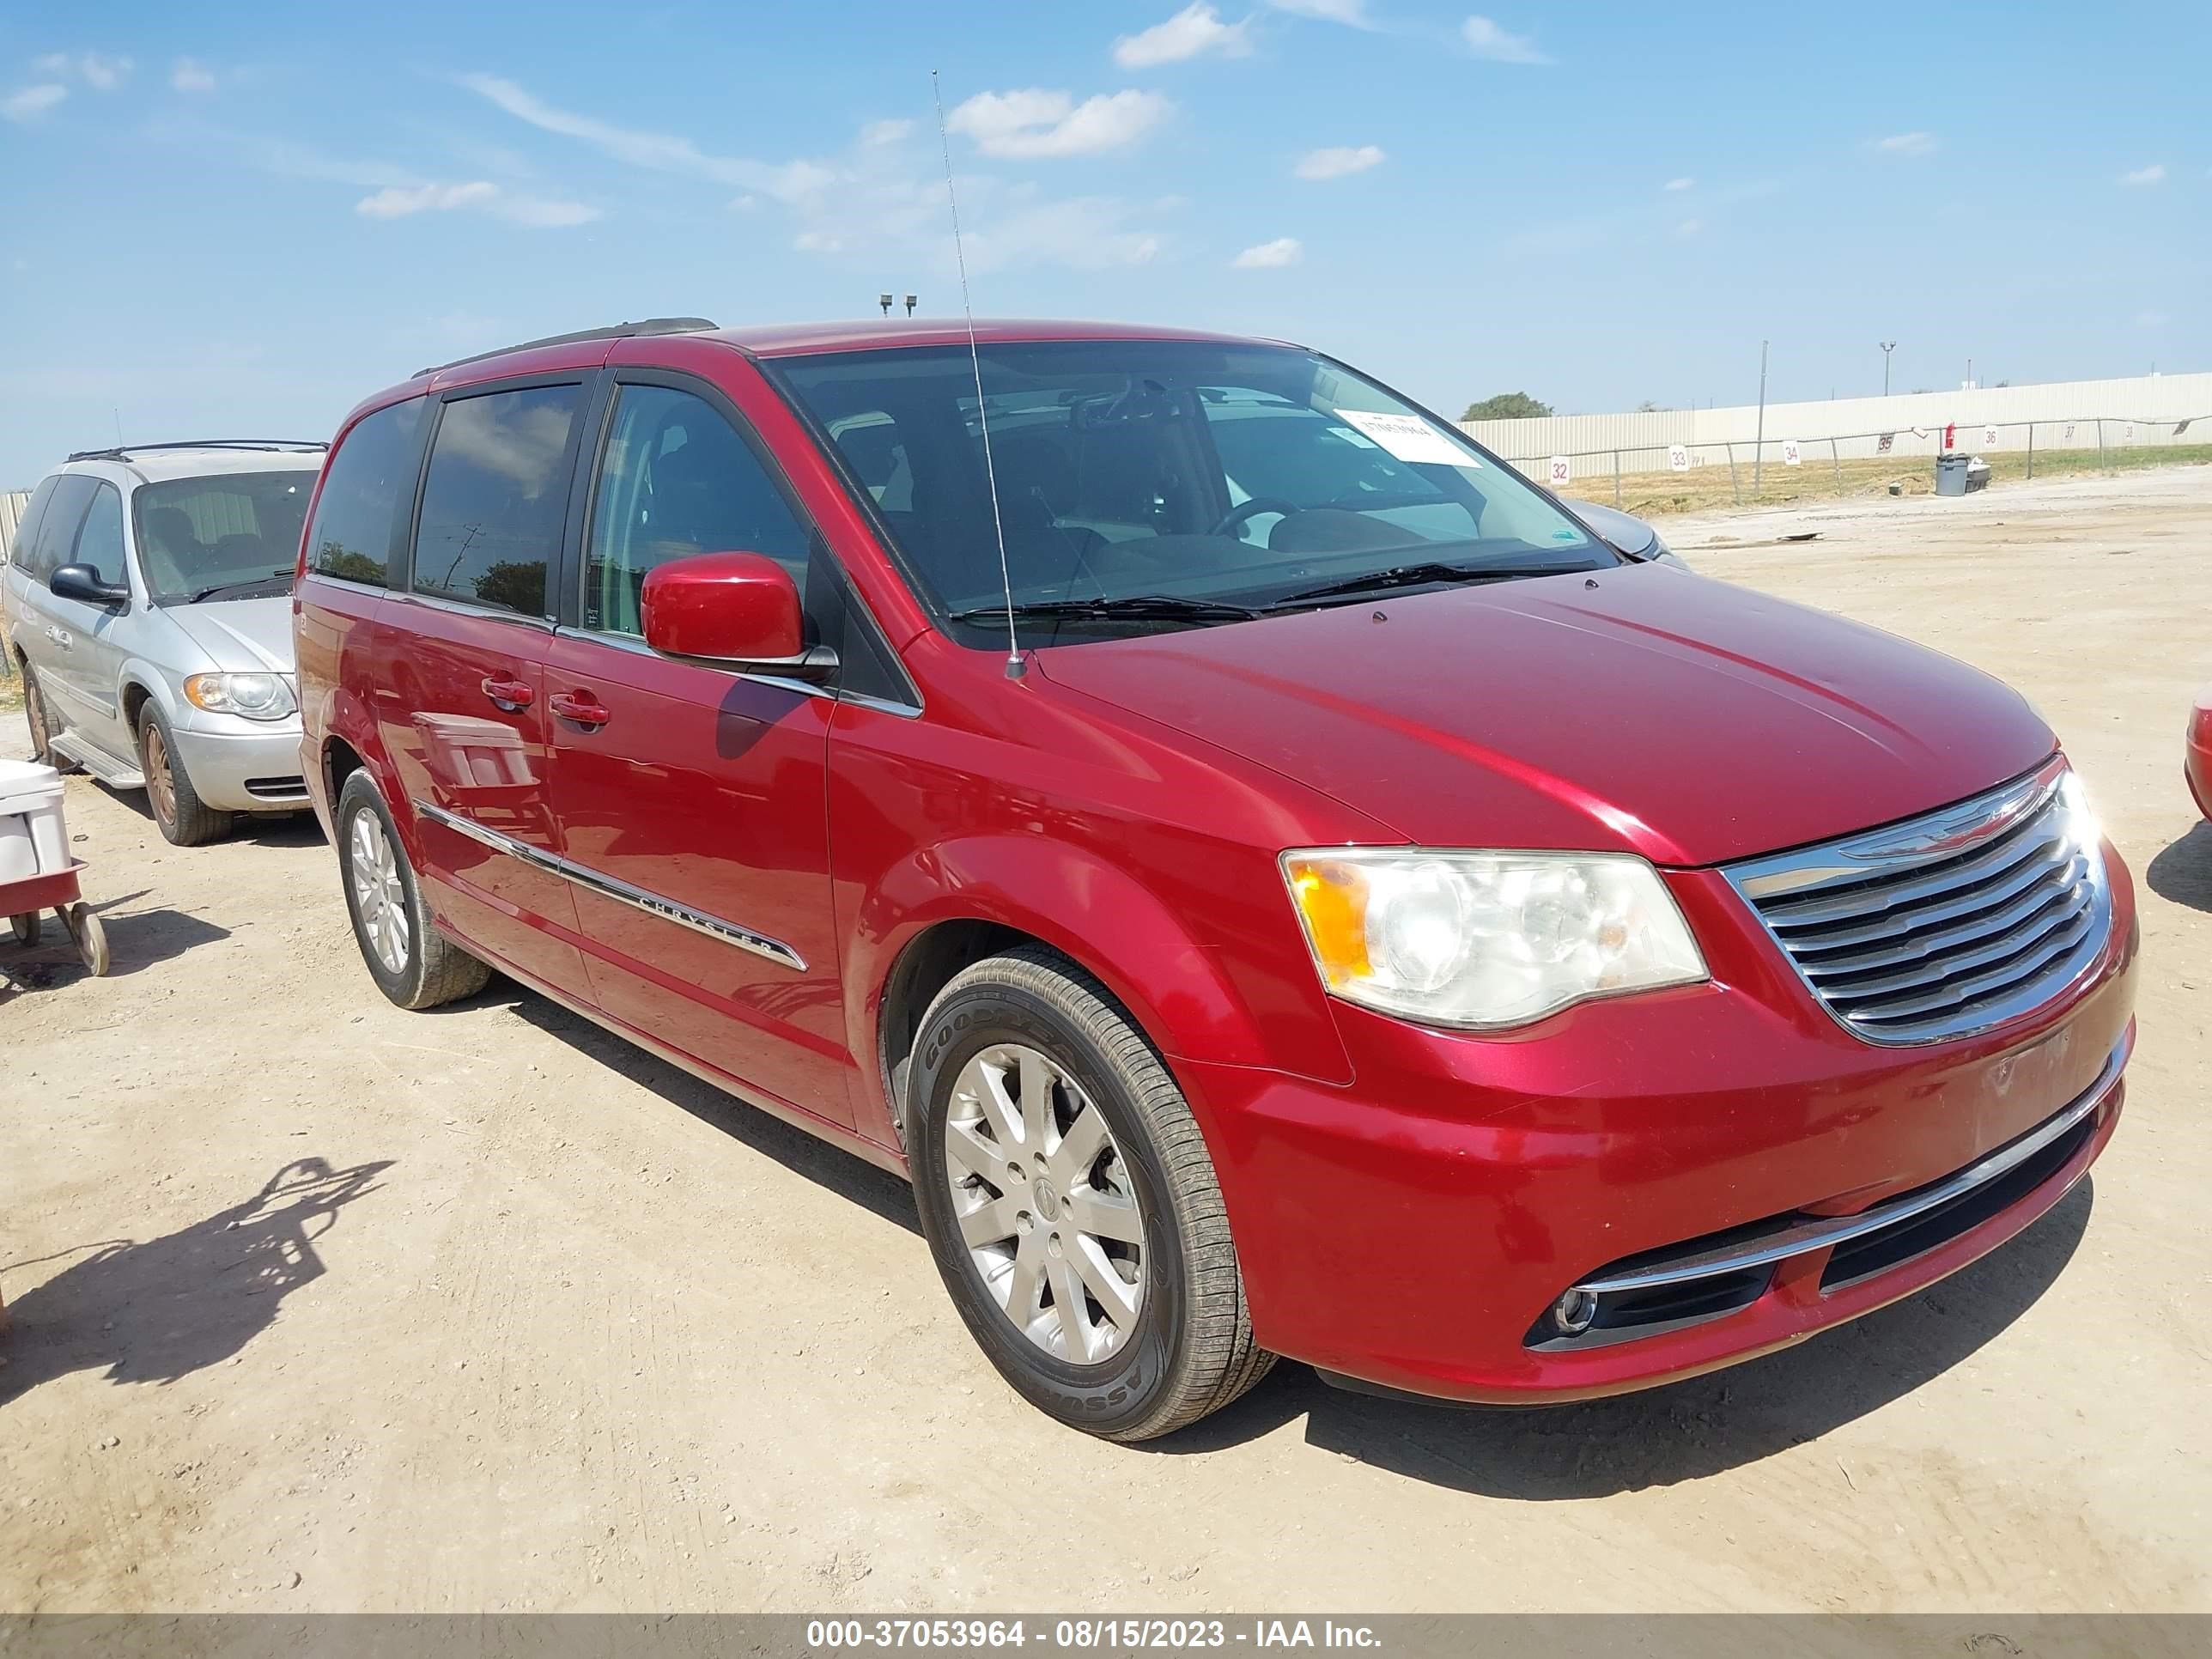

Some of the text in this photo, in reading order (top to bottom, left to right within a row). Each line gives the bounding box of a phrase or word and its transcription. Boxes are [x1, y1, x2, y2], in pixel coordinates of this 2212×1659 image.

[1986, 431, 1996, 444] 36
[2065, 426, 2075, 438] 37
[1879, 436, 1892, 450] 35
[1672, 452, 1686, 465] 33
[1786, 447, 1797, 460] 34
[1553, 463, 1567, 479] 32
[639, 897, 772, 953] CHRYSLER
